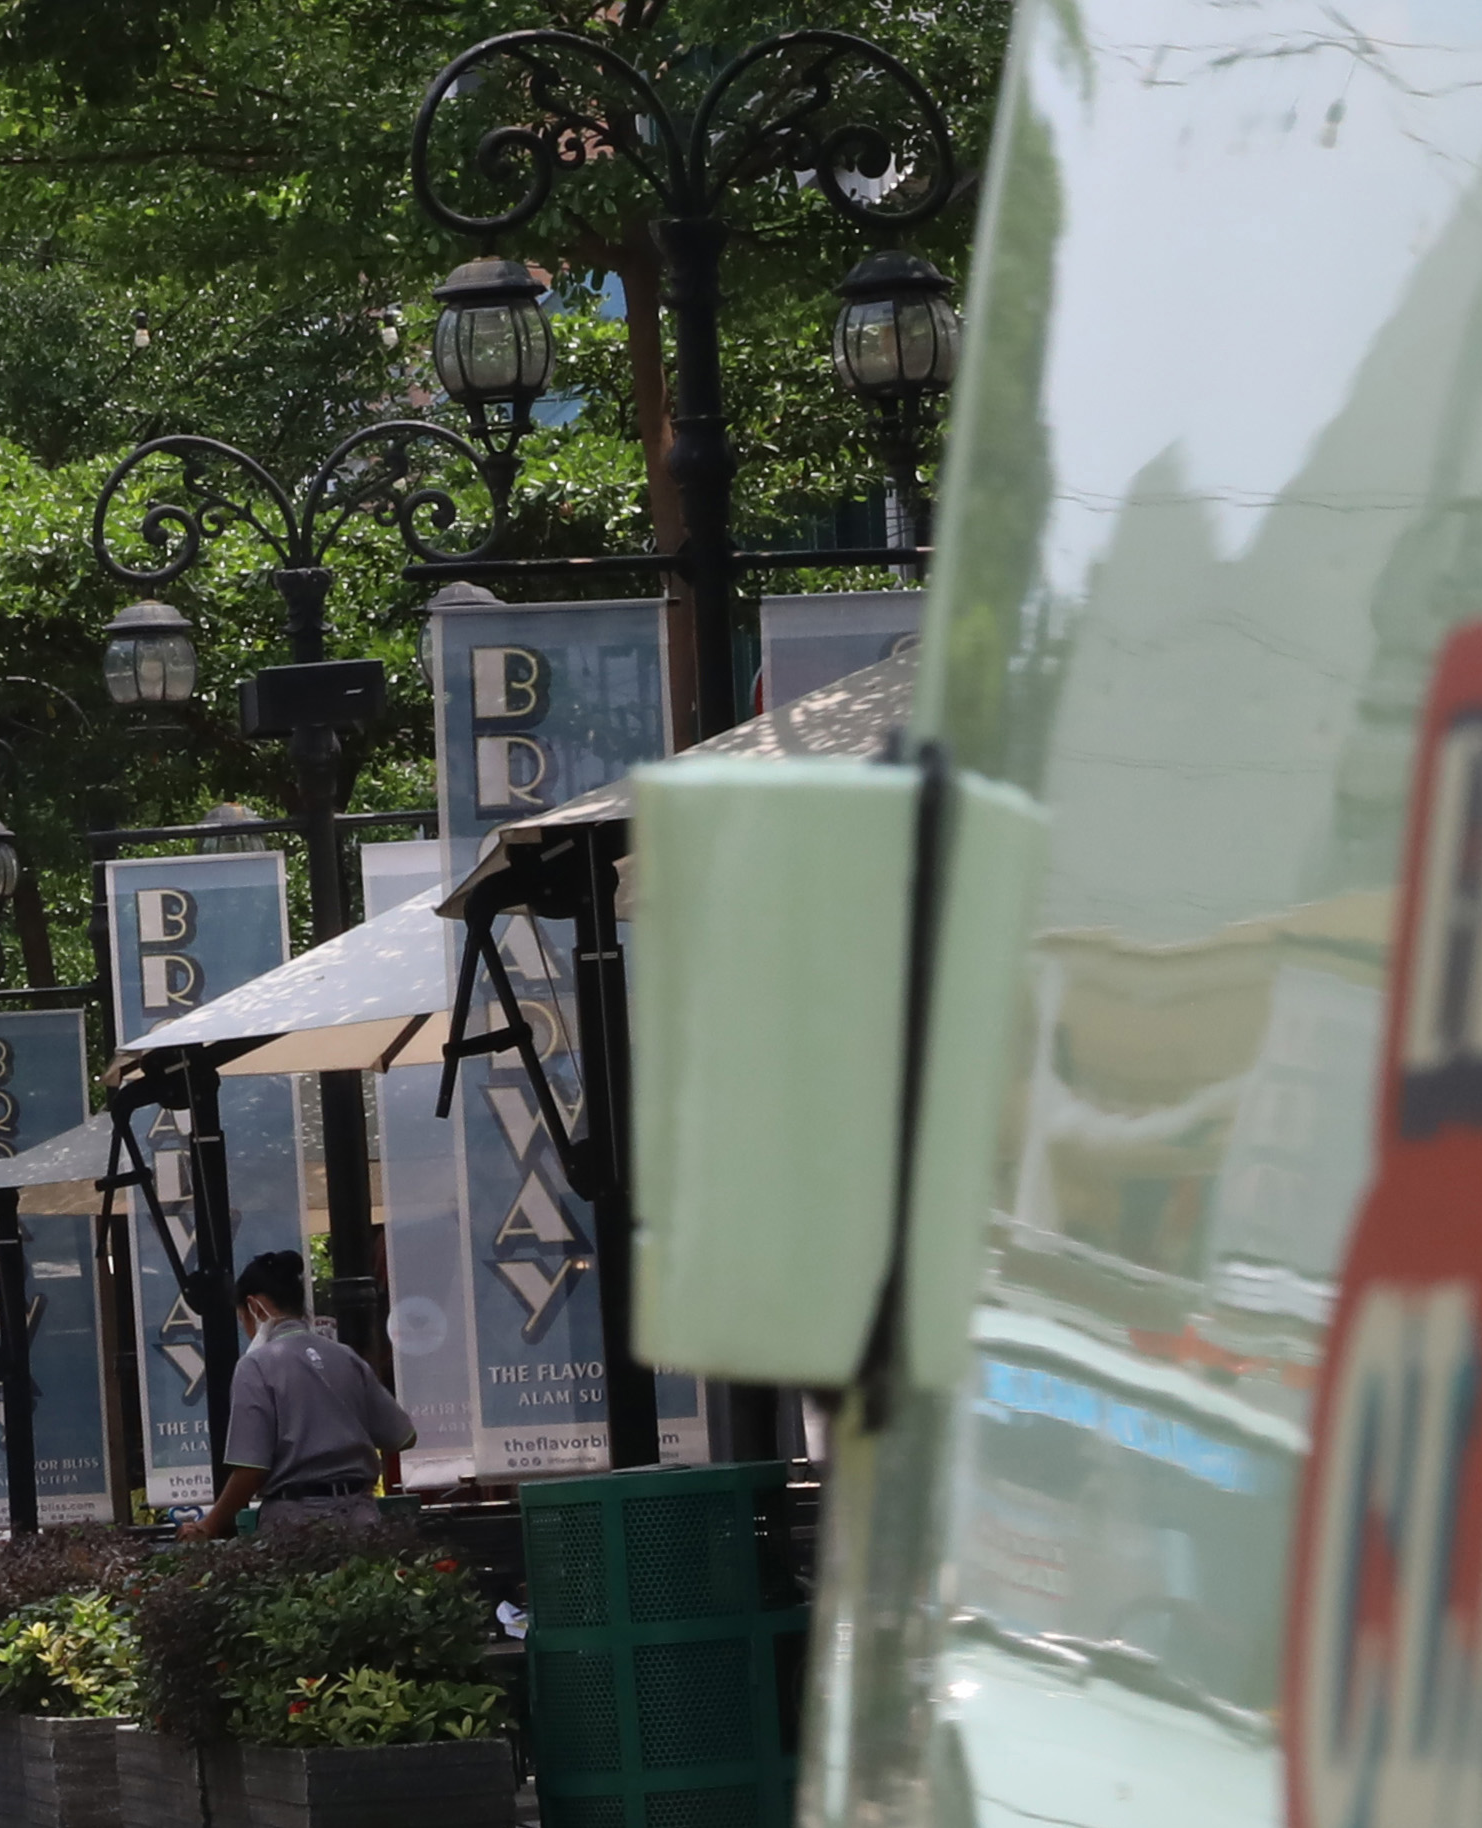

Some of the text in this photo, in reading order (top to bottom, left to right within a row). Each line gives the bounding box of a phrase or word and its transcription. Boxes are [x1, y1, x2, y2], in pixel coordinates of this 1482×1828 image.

[488, 1361, 604, 1384] THE FLAVO
[519, 1390, 570, 1406] ALAM
[156, 1421, 188, 1436] THE
[180, 1440, 208, 1453] ALA
[63, 1458, 99, 1470] BLISS
